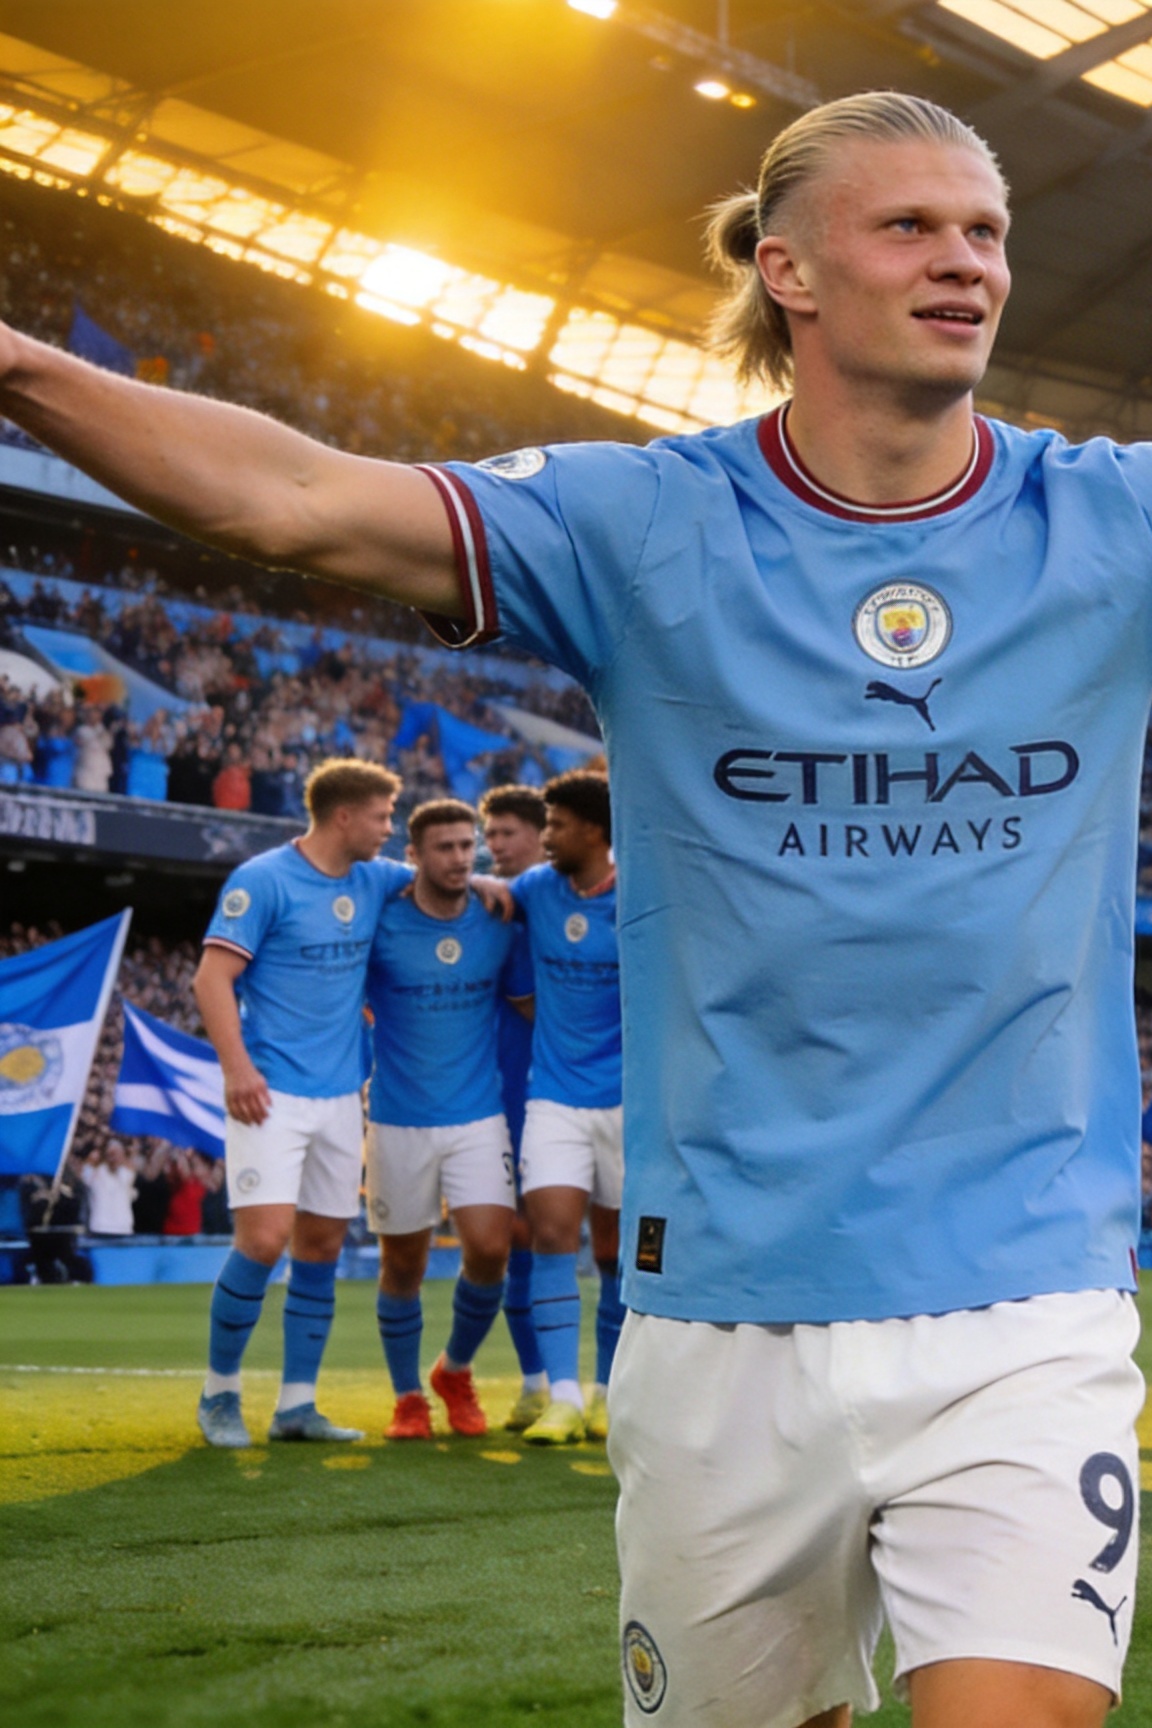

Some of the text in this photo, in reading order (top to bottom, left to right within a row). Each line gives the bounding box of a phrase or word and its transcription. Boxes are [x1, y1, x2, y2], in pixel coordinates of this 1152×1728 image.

[713, 740, 1080, 805] ETIHAD
[777, 816, 1023, 857] AIRWAYS
[1080, 1452, 1134, 1574] 9
